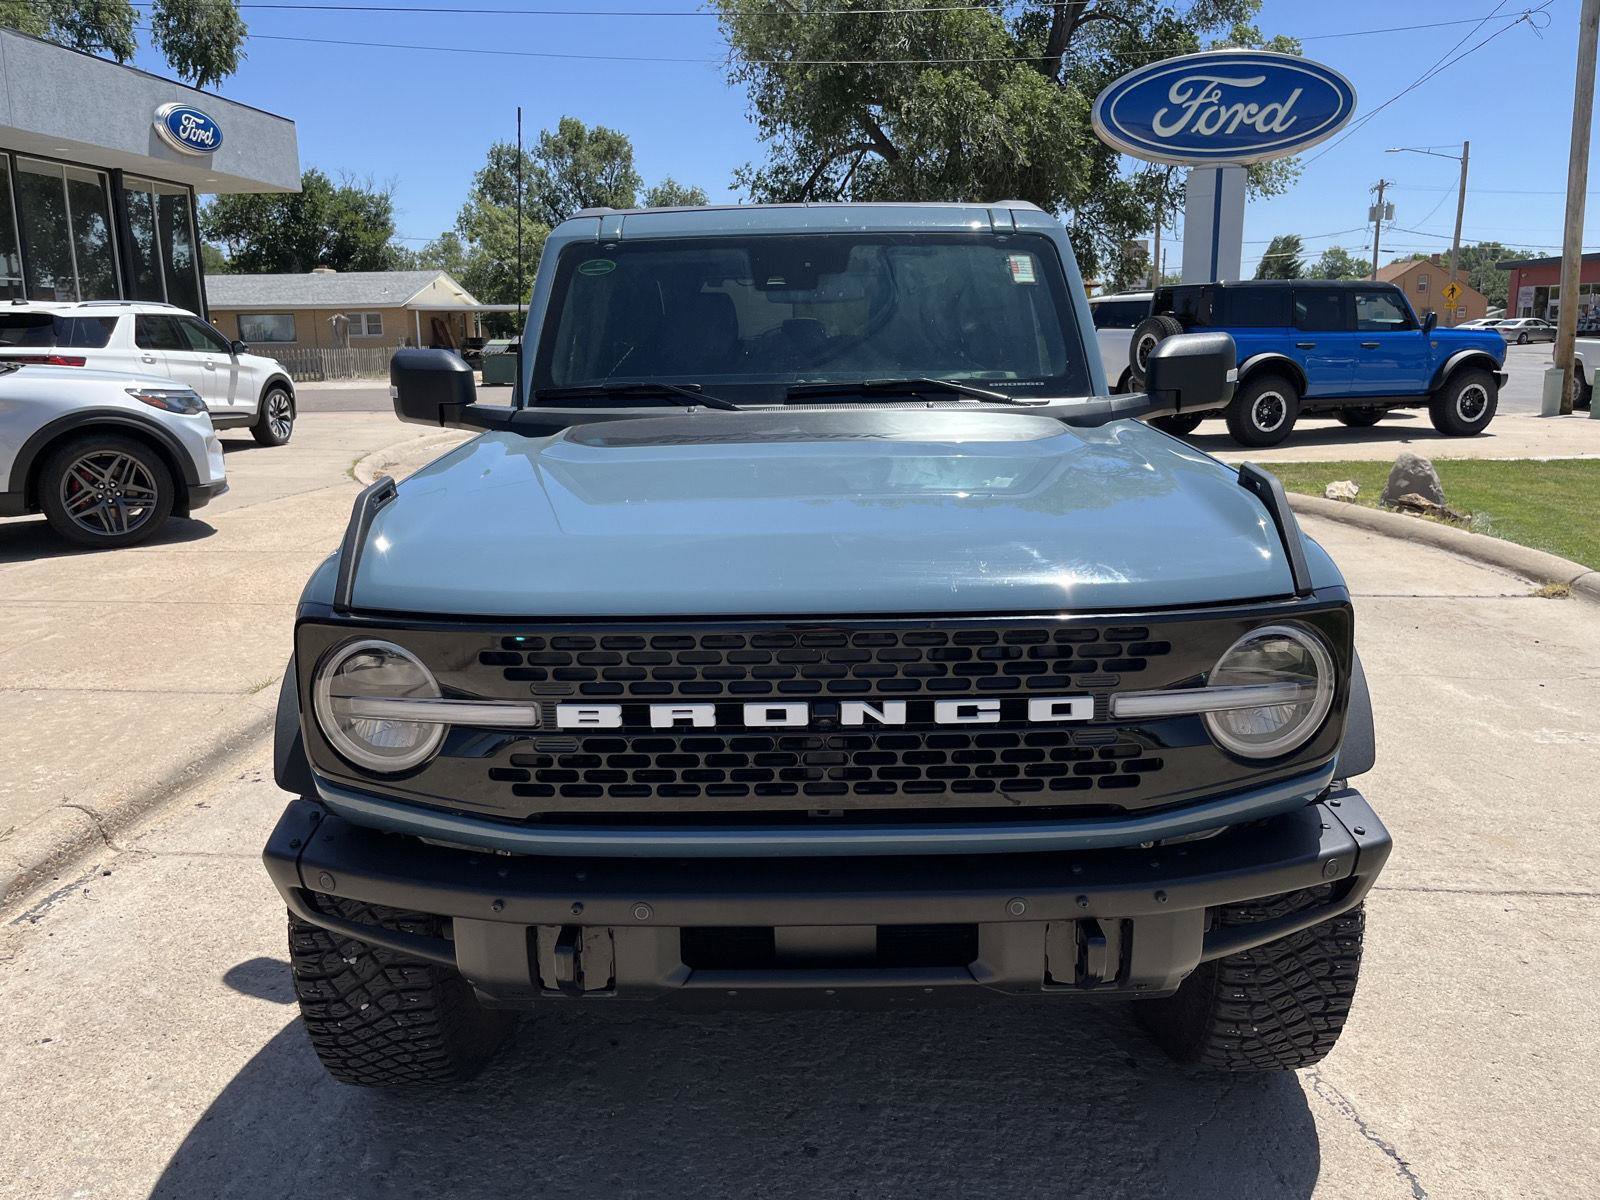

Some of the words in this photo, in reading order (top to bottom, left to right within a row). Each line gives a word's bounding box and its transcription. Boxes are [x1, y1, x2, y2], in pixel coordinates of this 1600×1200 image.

[1152, 75, 1303, 138] Ford
[179, 113, 214, 145] Ford
[556, 696, 1095, 728] BRONCO
